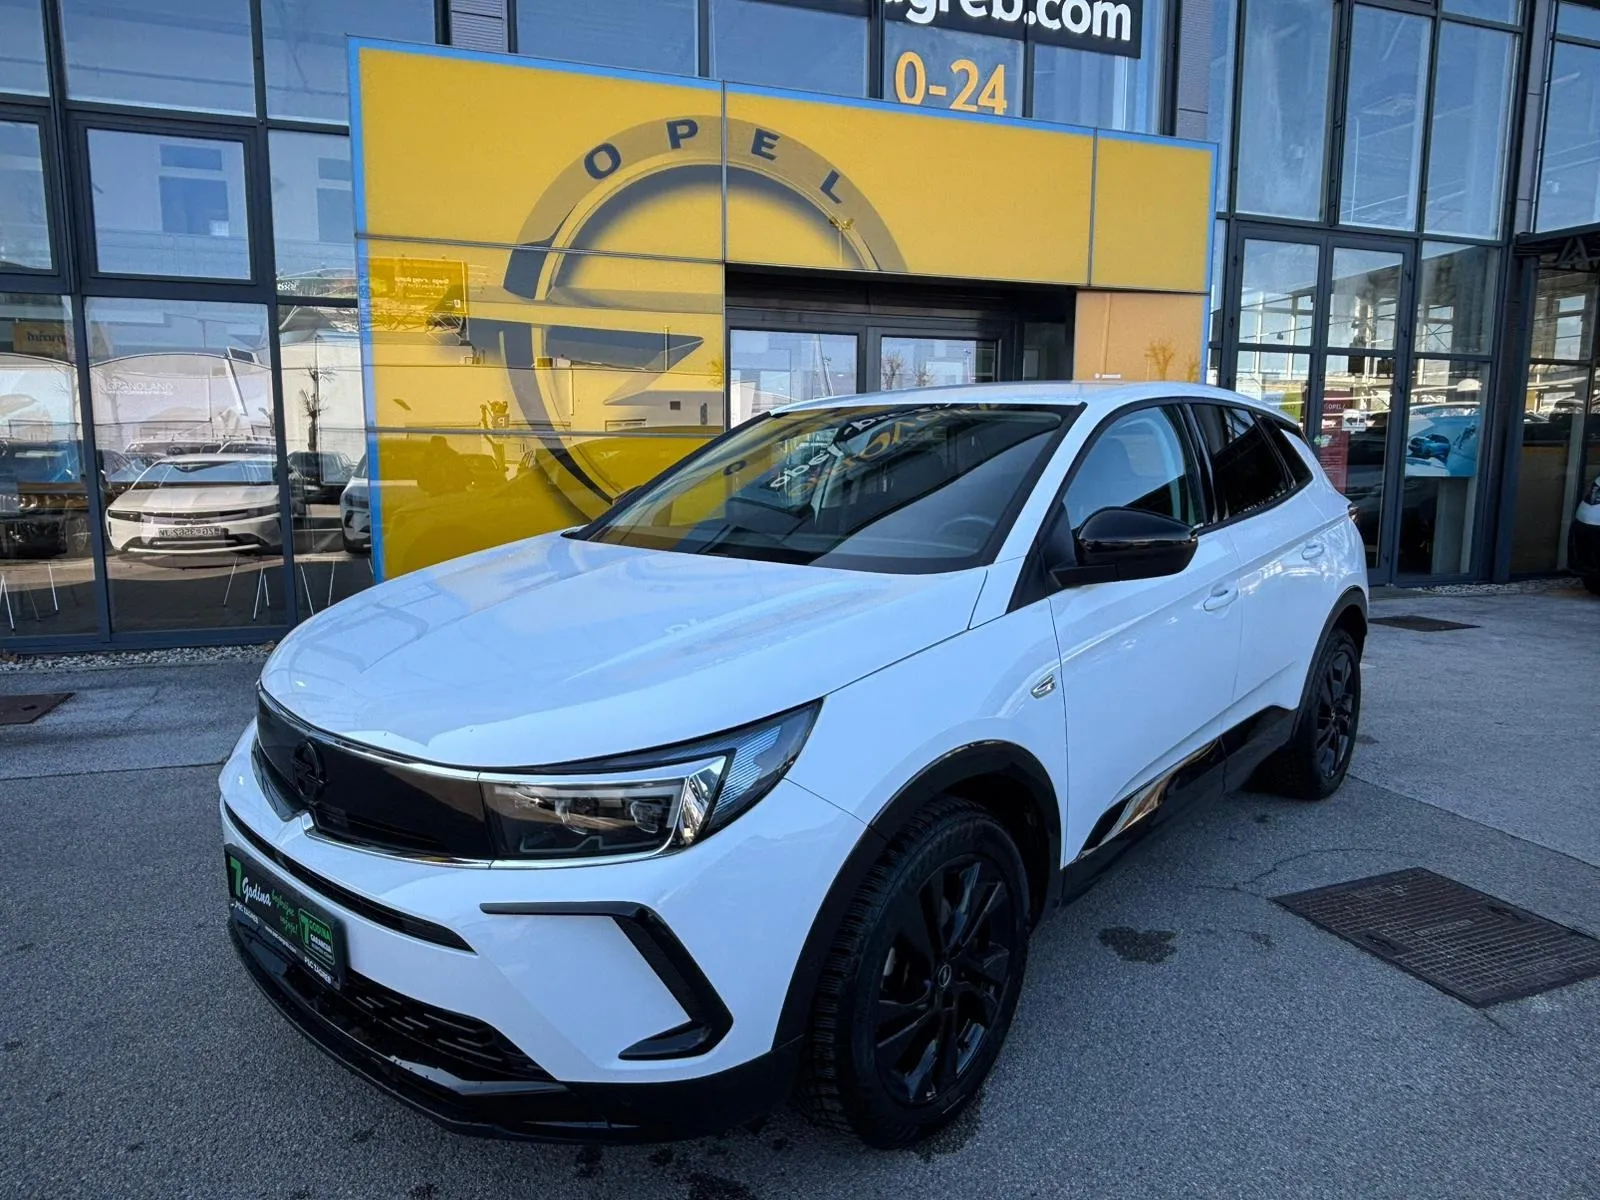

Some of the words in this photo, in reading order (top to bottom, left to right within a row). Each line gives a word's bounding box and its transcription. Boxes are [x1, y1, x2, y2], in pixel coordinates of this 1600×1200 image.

[895, 51, 1008, 116] 0-24
[584, 118, 842, 204] OPEL
[230, 855, 241, 897] 7
[242, 876, 271, 906] Godina
